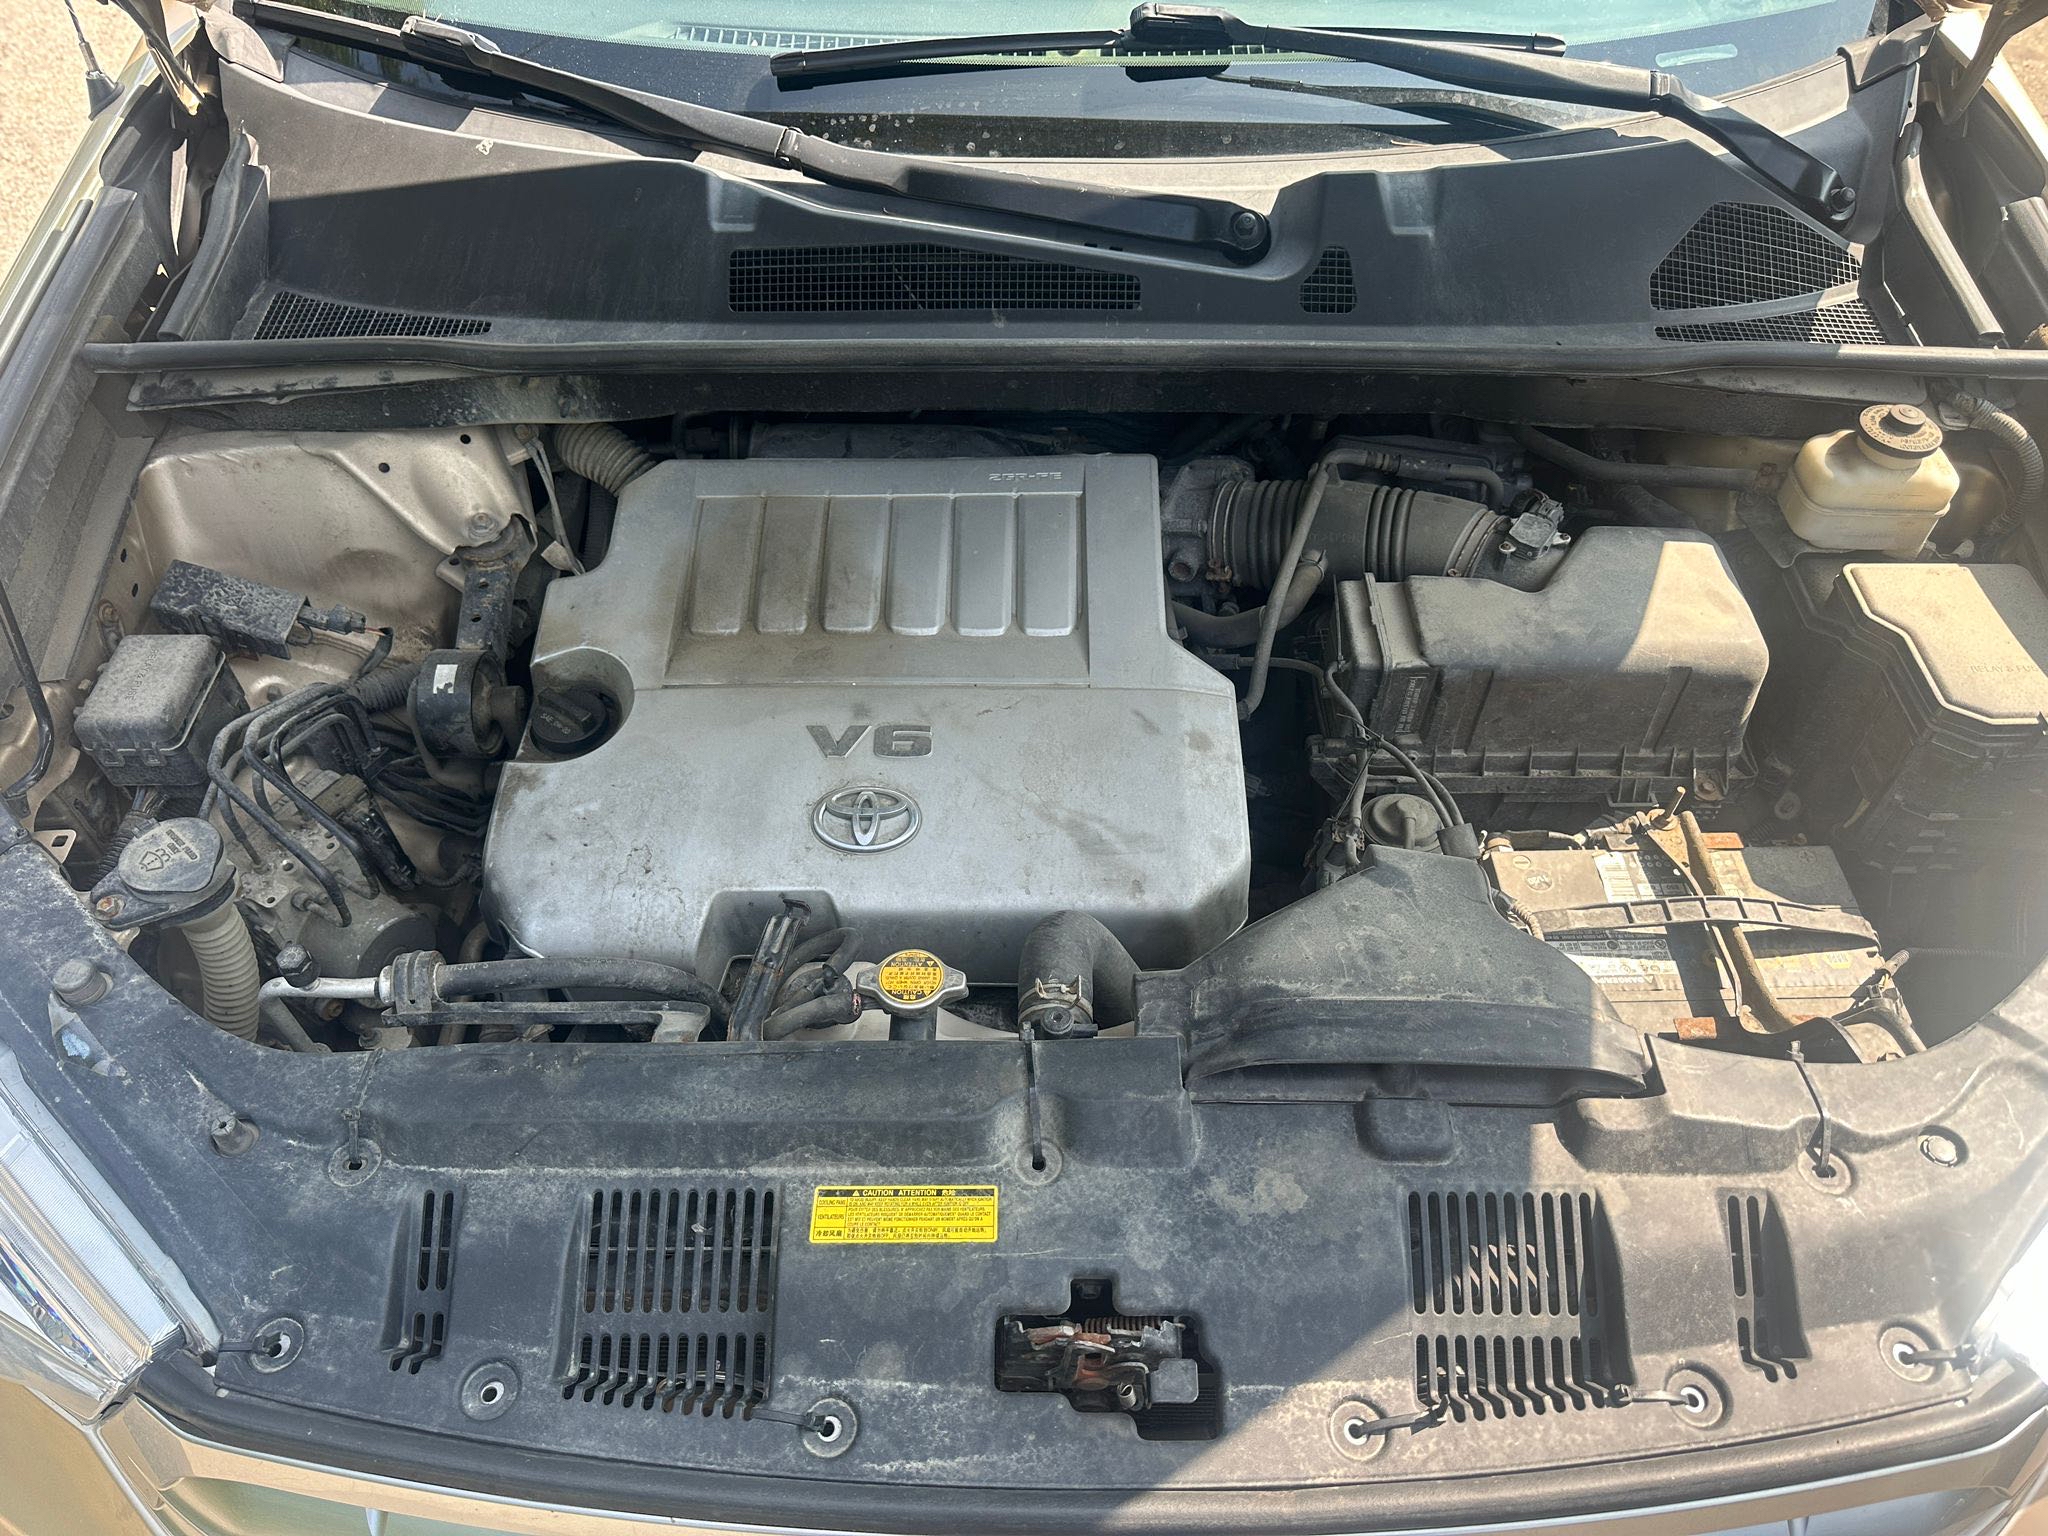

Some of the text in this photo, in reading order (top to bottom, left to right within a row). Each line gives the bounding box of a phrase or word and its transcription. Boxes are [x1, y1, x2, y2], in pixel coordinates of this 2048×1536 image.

[1969, 664, 2003, 673] RELAY
[806, 725, 933, 758] V6
[862, 1189, 894, 1197] CAUTION
